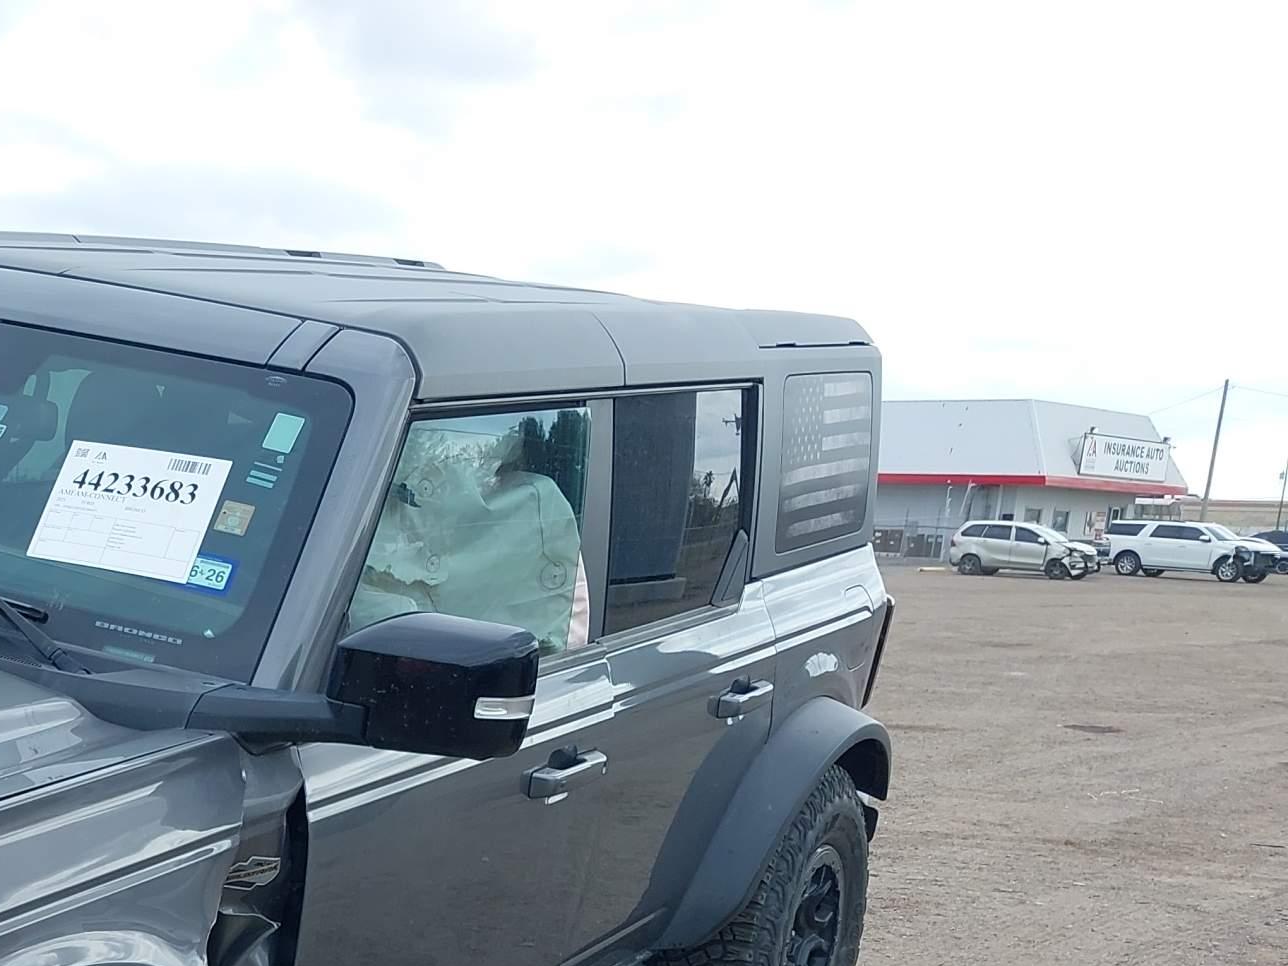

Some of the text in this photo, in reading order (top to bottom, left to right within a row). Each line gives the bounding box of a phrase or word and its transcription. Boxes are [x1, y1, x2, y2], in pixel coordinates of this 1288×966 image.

[1104, 441, 1164, 461] INSURANCE AUTO
[1114, 459, 1150, 475] AUCTIONS
[73, 468, 199, 505] 44233683
[205, 568, 226, 583] 26
[95, 621, 182, 645] BRONCO
